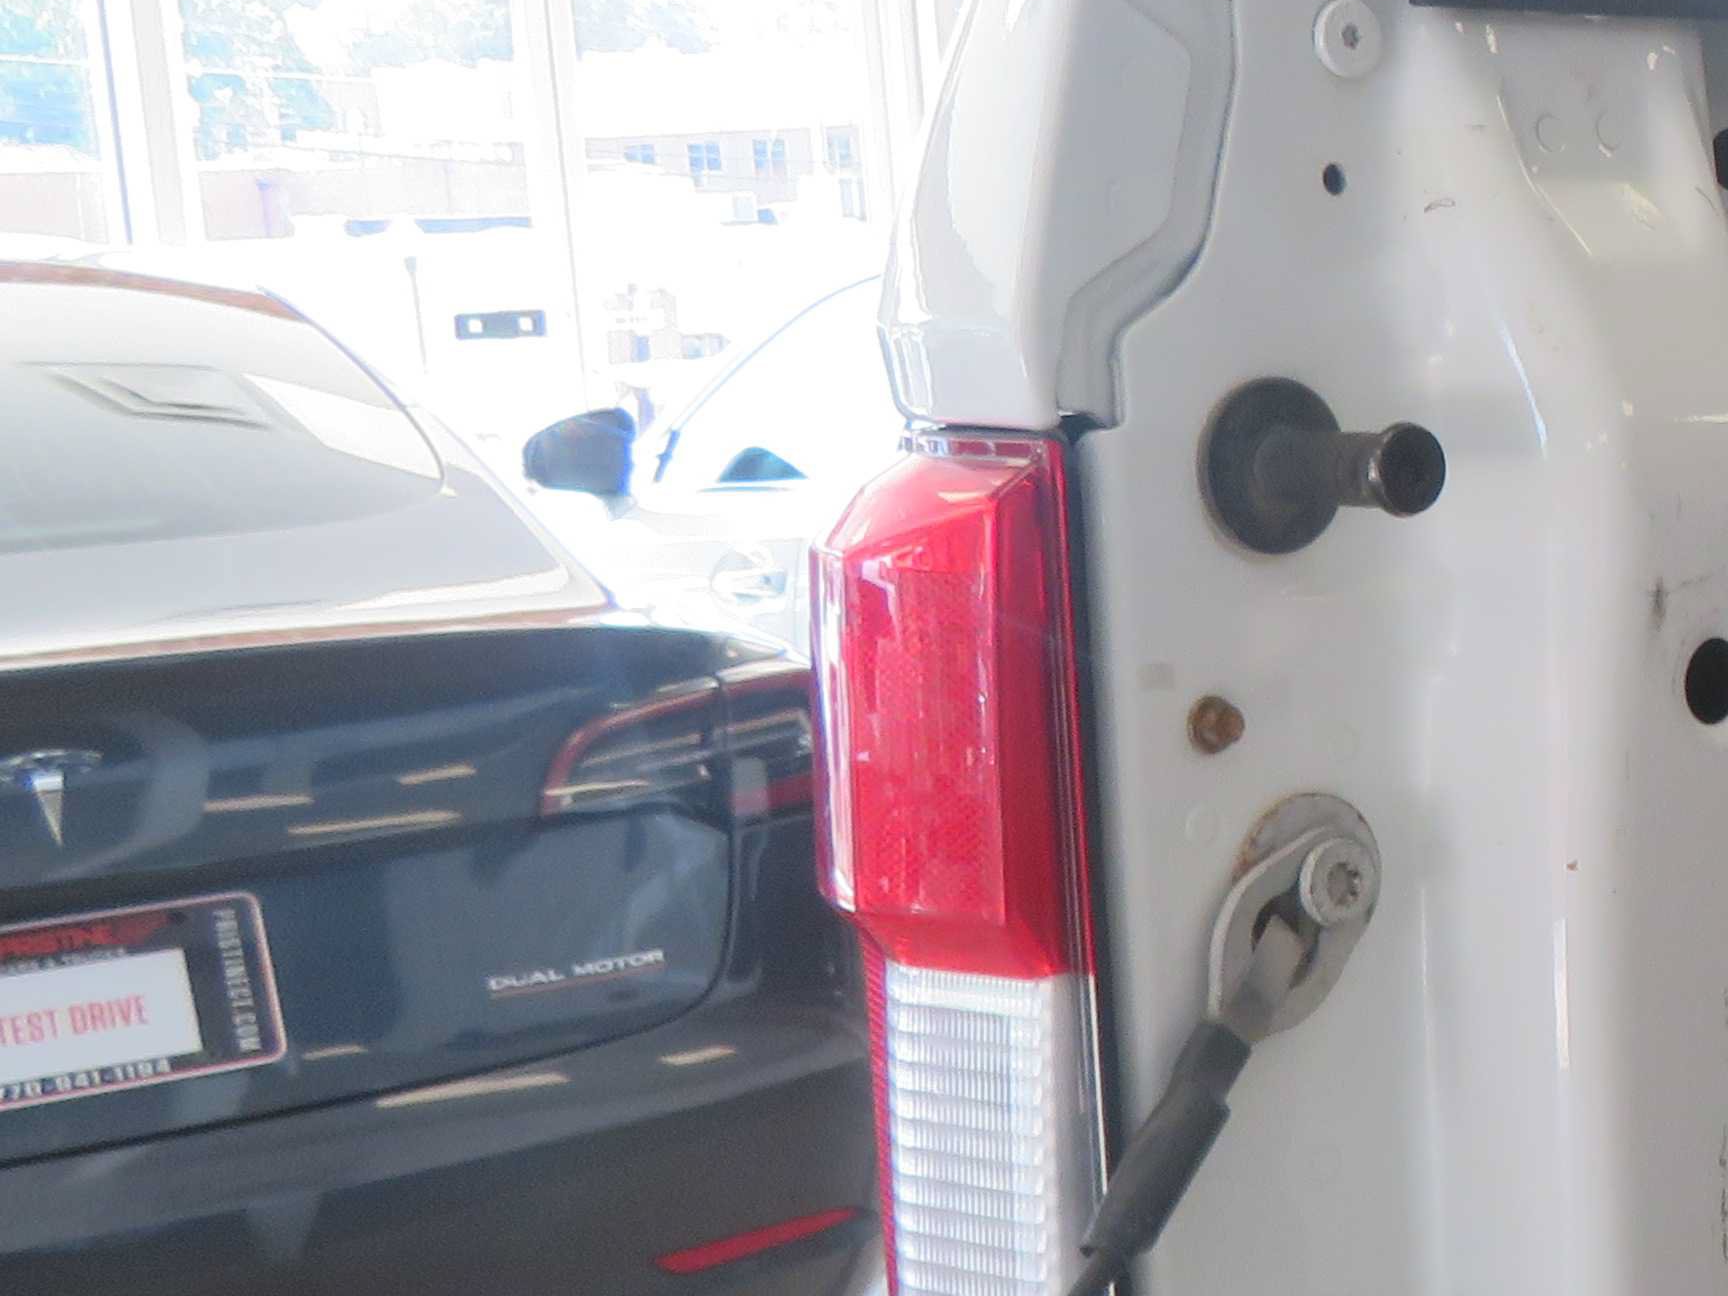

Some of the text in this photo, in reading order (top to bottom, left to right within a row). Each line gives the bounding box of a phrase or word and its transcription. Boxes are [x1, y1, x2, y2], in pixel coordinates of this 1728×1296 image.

[488, 949, 665, 991] DUAL MOTOR
[68, 993, 150, 1035] DRIVE
